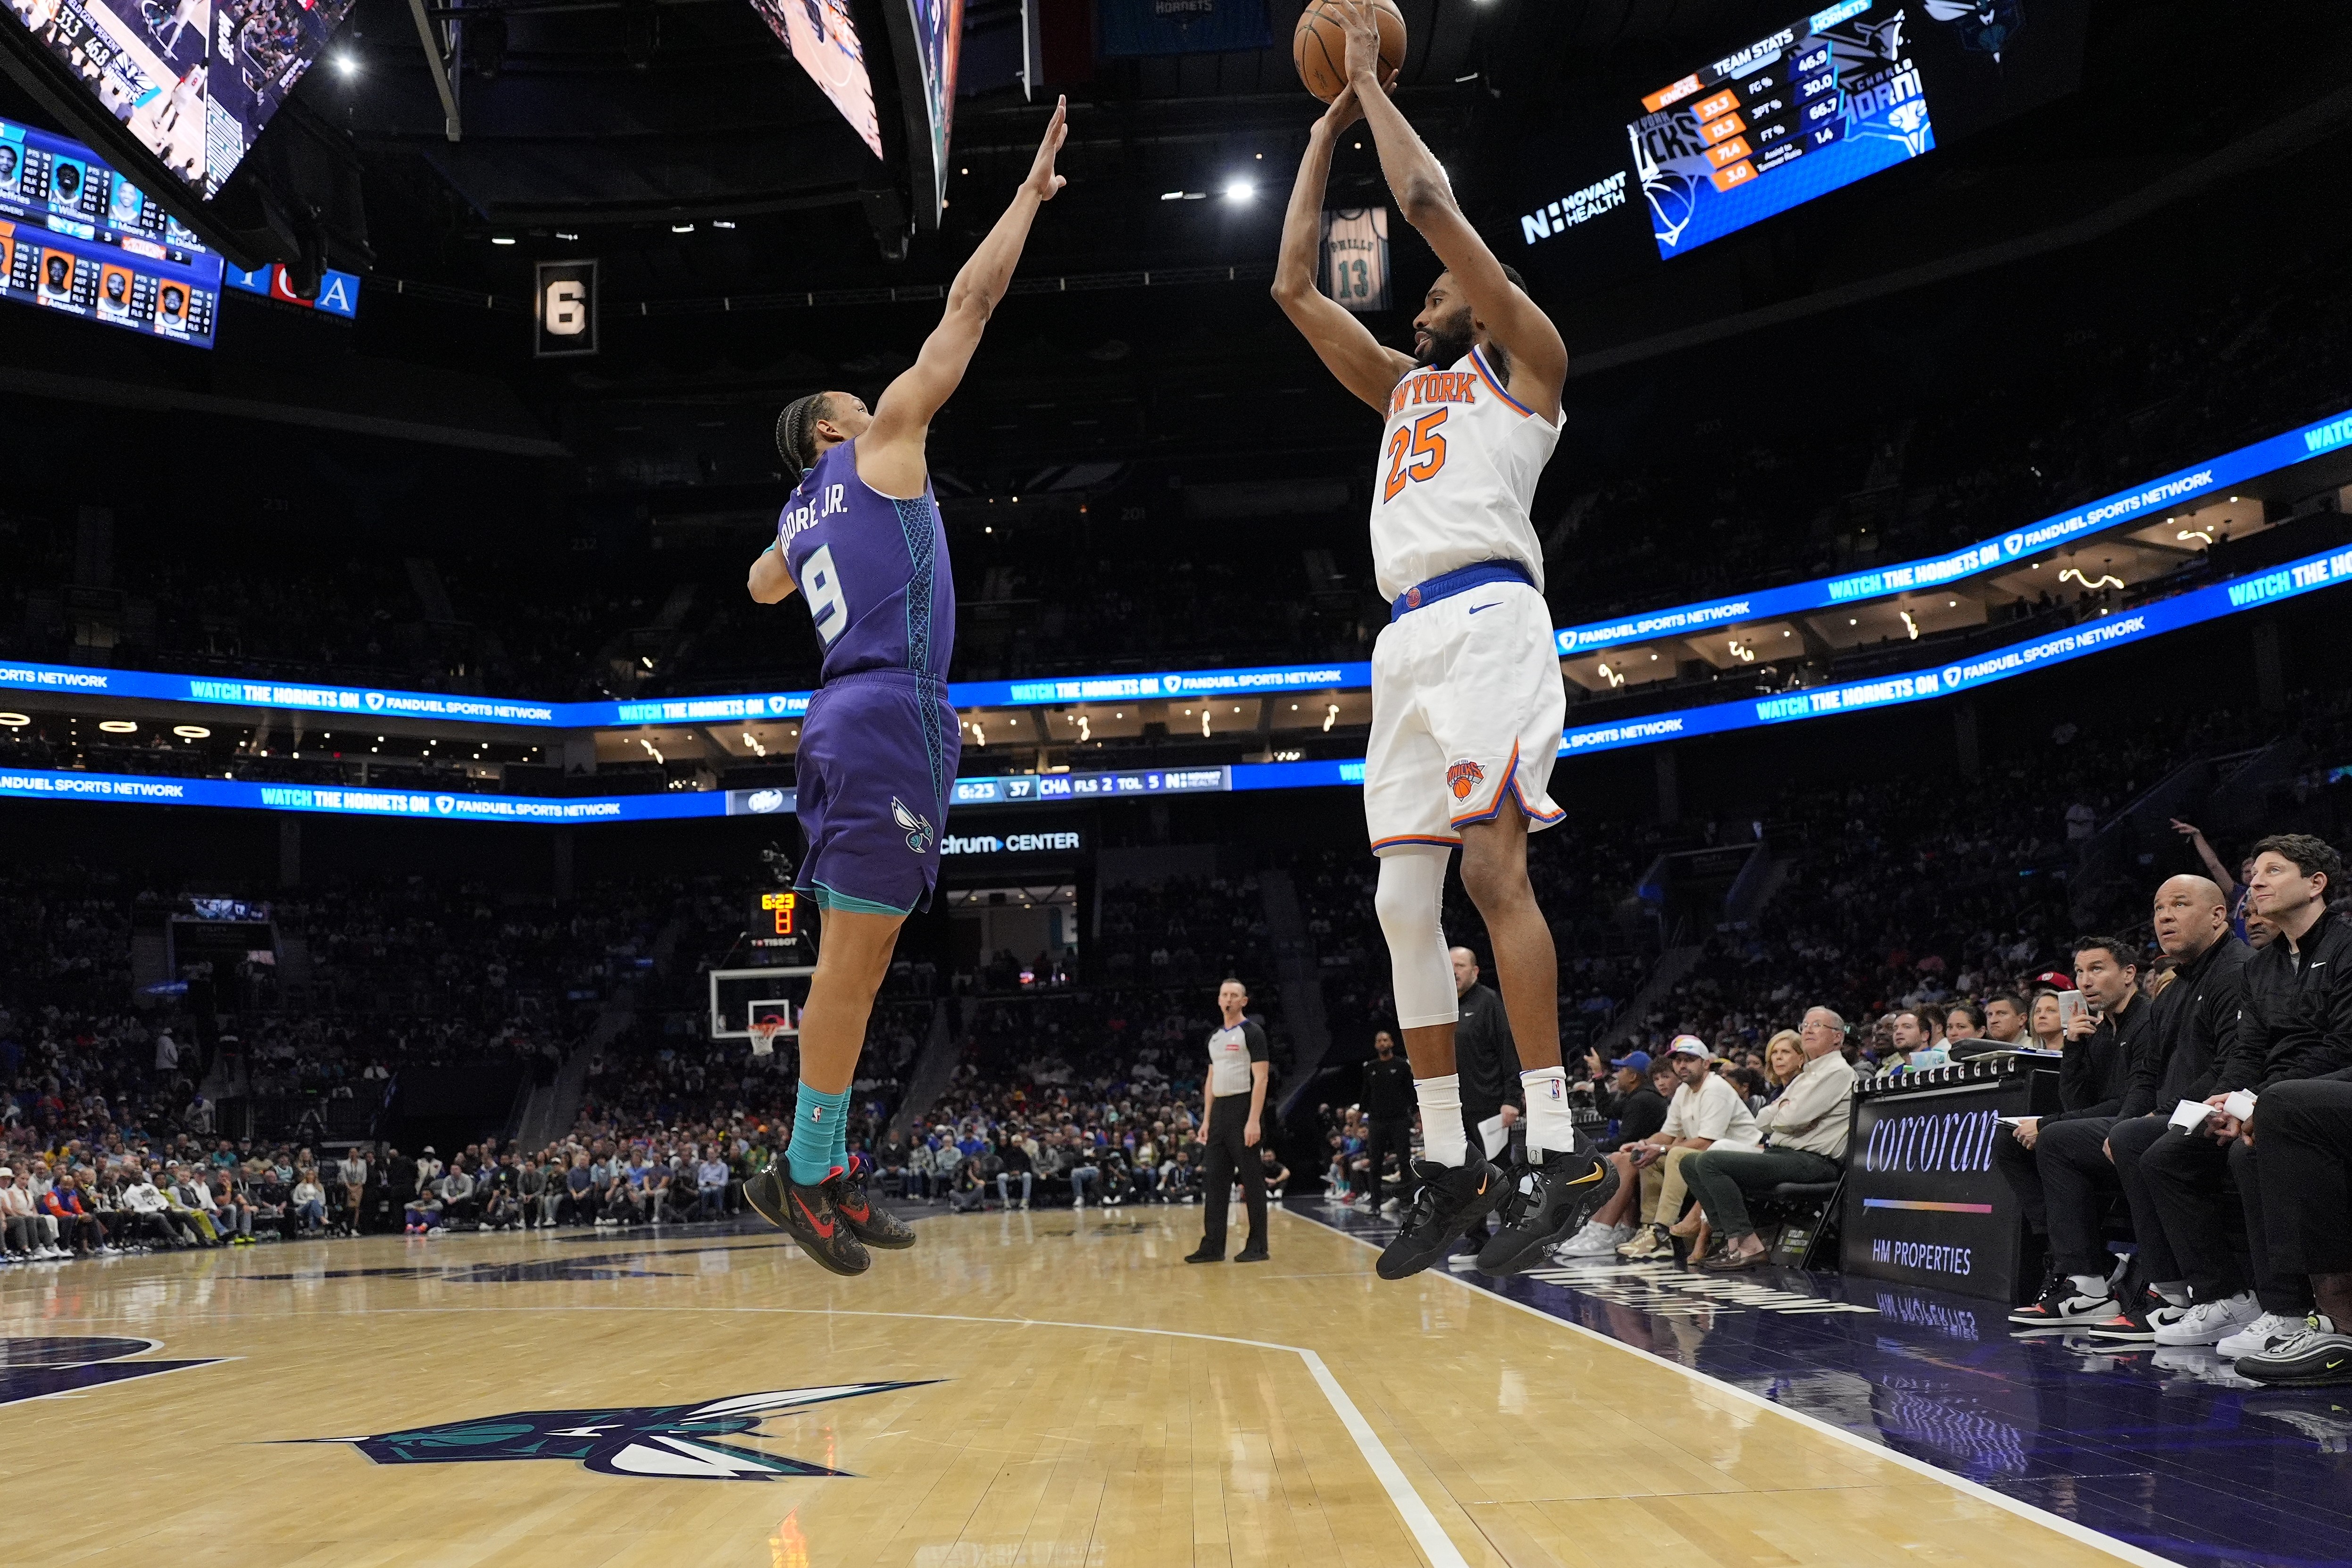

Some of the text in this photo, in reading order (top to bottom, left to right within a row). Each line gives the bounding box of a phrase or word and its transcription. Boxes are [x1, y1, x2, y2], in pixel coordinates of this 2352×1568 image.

[55, 5, 83, 37] 33.3
[80, 8, 97, 27] GOAL
[94, 25, 121, 54] PERCENT
[1812, 0, 1869, 33] HORNETS
[84, 37, 110, 67] 46.8
[1713, 28, 1793, 76] TEAM STATS
[1660, 82, 1698, 107] KNICKS
[1703, 96, 1729, 117] 33.3
[1749, 81, 1762, 94] FG
[1798, 50, 1827, 72] 46.9
[1751, 103, 1770, 119] 3PT
[1803, 74, 1833, 97] 30.0
[1717, 142, 1741, 160] 71.4
[1760, 128, 1773, 142] FT
[1809, 97, 1837, 120] 66.7
[1726, 166, 1746, 183] 3.0
[1815, 127, 1834, 144] 1.4
[1561, 170, 1626, 212] NOVANT
[1566, 188, 1626, 227] HEALTH
[58, 204, 95, 223] Williams
[117, 221, 145, 236] Moore
[175, 237, 206, 253] Diabate
[175, 250, 183, 261] 3
[1339, 259, 1369, 298] 13
[47, 298, 86, 315] Anunoby
[107, 313, 139, 328] Bridges
[546, 280, 585, 335] 6
[165, 328, 190, 341] Towns
[1412, 372, 1477, 405] YORK
[2304, 417, 2352, 451] WATC
[1384, 406, 1448, 505] 25
[821, 484, 848, 518] JR.
[1828, 470, 2213, 600] WATCH THE HORNETS ON FANDUEL SPORTS NETWORK
[801, 542, 848, 645] 9
[2228, 572, 2291, 606] WATCH
[2291, 559, 2329, 588] THE
[1576, 601, 1750, 644] FANDUEL SPORTS NETWORK
[38, 671, 107, 688] NETWORK
[1756, 616, 2145, 720] WATCH THE HORNETS ON FANDUEL SPORTS NETWORK
[191, 681, 551, 720] WATCH THE HORNETS ON FANDUEL SPORTS NETWORK
[1011, 670, 1342, 700] WATCH THE HORNETS ON FANDUEL SPORTS NETWORK
[618, 699, 764, 720] WATCH THE HORNETS ON
[1571, 729, 1619, 747] SPORTS
[1620, 718, 1683, 739] NETWORK
[55, 779, 112, 793] SPORTS
[114, 782, 183, 797] NETWORK
[958, 784, 994, 799] 6:23
[1010, 782, 1029, 796] 37
[1040, 779, 1070, 795] CHA
[1075, 779, 1097, 792] FLS
[1102, 777, 1112, 791] 2
[1117, 777, 1143, 790] TOL
[1148, 776, 1159, 789] 5
[1339, 763, 1366, 781] WAT
[1447, 761, 1484, 782] KNICKS
[261, 788, 620, 817] WATCH THE HORNETS ON FANDUEL SPORTS NETWORK
[1006, 832, 1080, 851] CENTER
[762, 893, 794, 909] 6:23
[775, 908, 791, 934] 8
[763, 937, 798, 947] TISSOT
[1853, 1056, 2015, 1093] G G G G G G G G G G G G
[1866, 1109, 1999, 1172] corcoran
[1872, 1238, 1972, 1276] HM PROPERTIES
